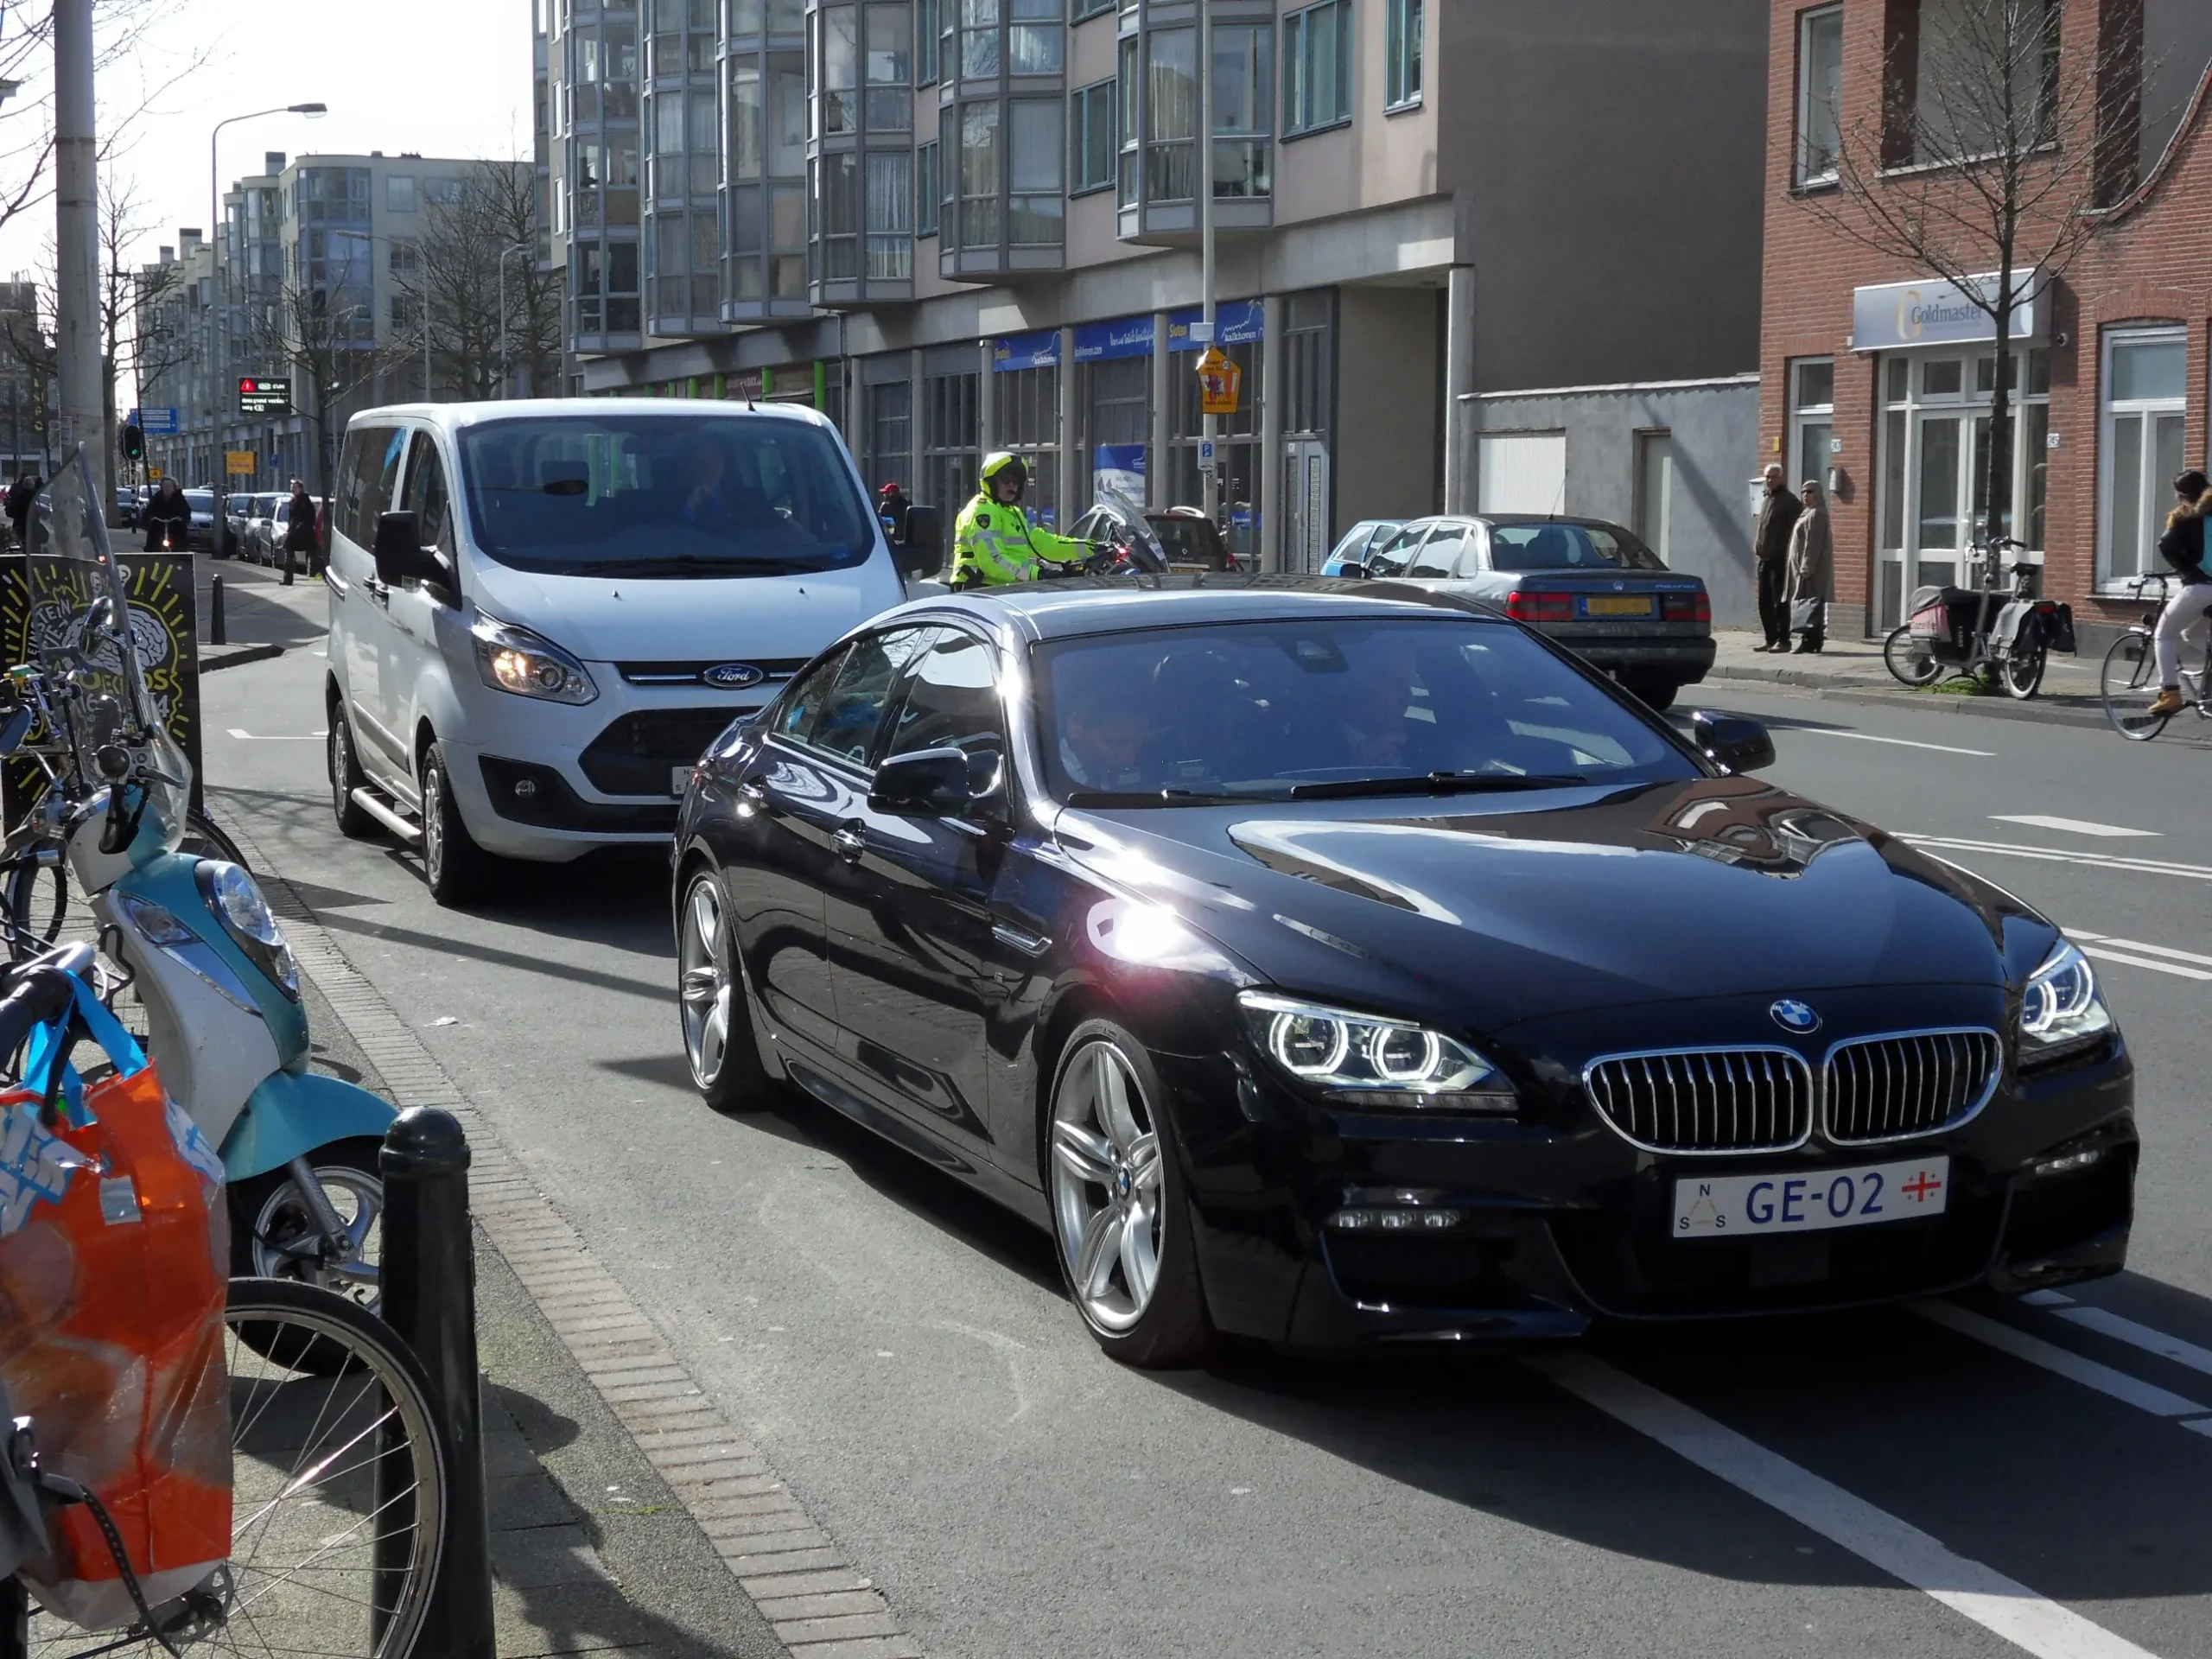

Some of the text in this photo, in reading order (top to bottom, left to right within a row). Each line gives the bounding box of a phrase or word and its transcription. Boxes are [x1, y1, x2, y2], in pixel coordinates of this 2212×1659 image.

[1911, 302, 1983, 326] Goldmaster
[717, 666, 750, 681] Ford
[1699, 1184, 1711, 1197] N
[1745, 1172, 1885, 1224] GE-02
[1679, 1214, 1726, 1230] S S
